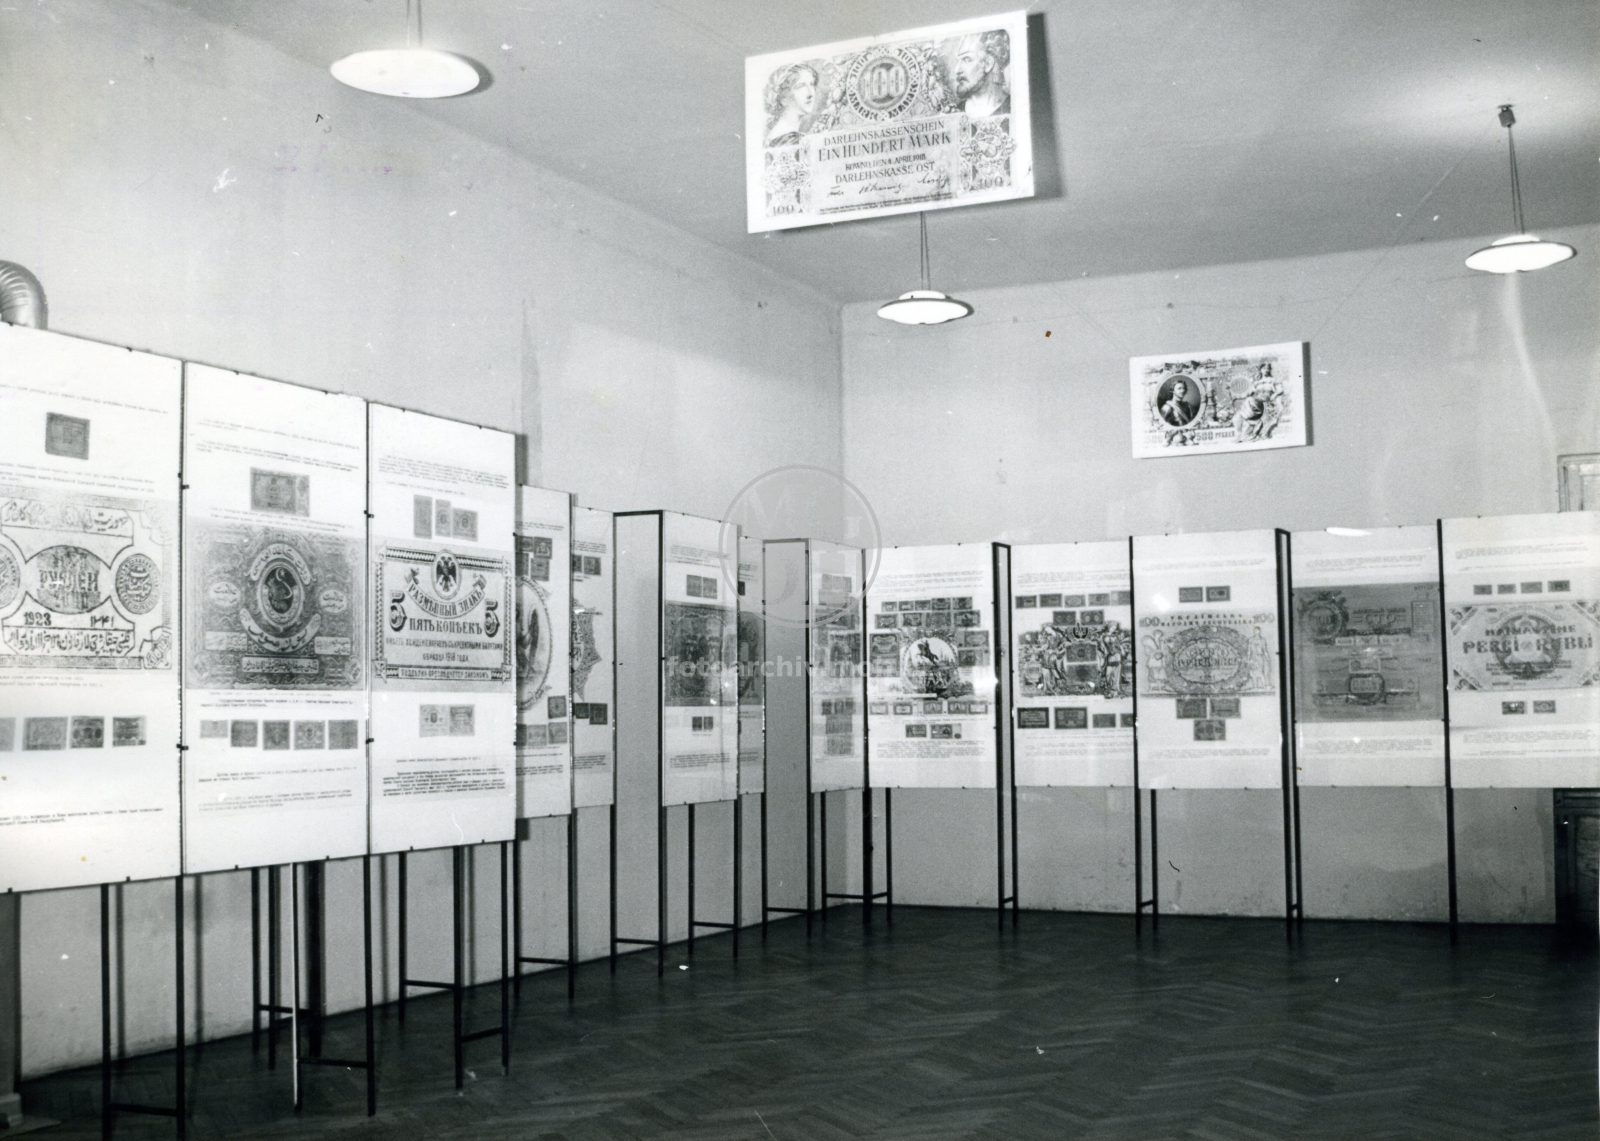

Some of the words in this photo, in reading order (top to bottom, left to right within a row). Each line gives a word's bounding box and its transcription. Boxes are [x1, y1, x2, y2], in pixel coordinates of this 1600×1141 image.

[861, 67, 905, 101] 100
[824, 120, 945, 147] DARLEHNSKASSENSCHEIN
[818, 147, 840, 161] EIN
[842, 138, 906, 158] HUNDERT
[909, 131, 952, 149] MARK
[835, 163, 914, 184] DARLEHNSKASSE
[916, 161, 935, 173] OST
[773, 204, 794, 216] 100
[1196, 431, 1214, 441] 500
[24, 611, 52, 626] 1923
